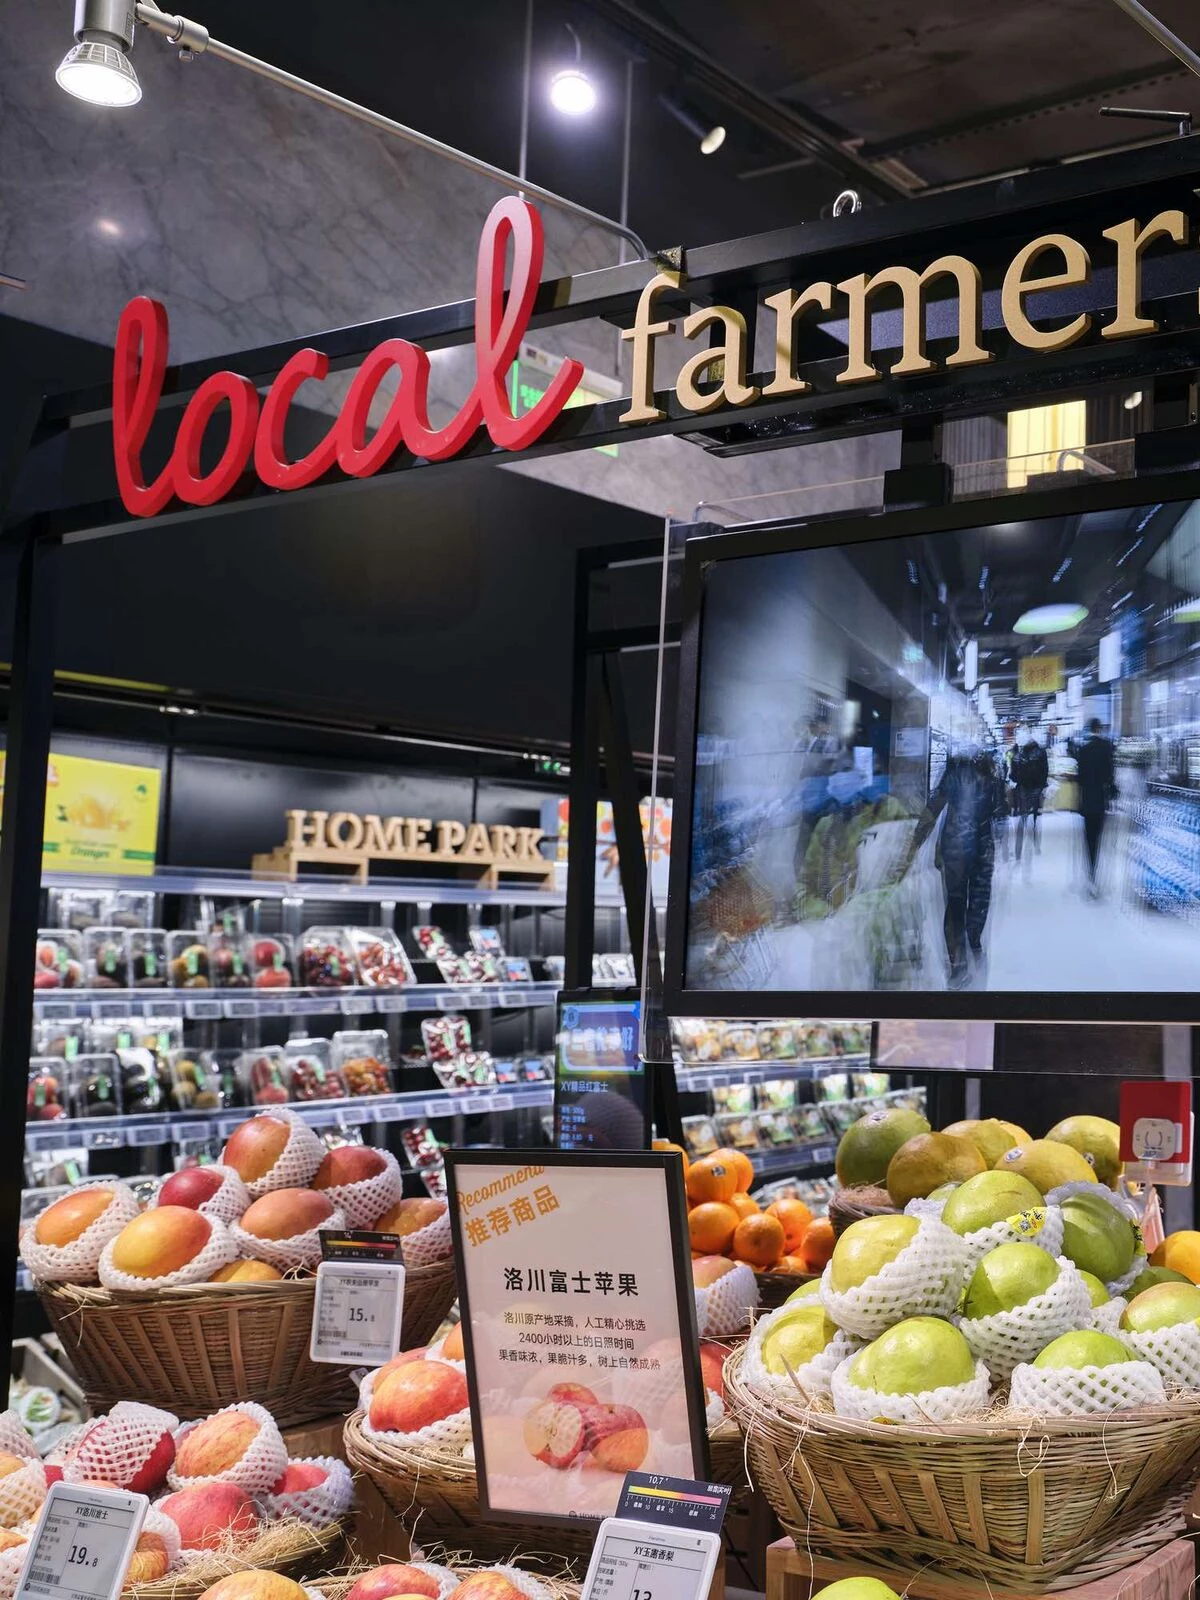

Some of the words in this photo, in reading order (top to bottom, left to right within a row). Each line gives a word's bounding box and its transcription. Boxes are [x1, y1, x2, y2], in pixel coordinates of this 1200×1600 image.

[112, 195, 585, 518] local
[286, 809, 433, 851] HOME
[436, 819, 545, 861] PARK
[465, 1185, 560, 1247] 推荐商品
[504, 1267, 639, 1297] 洛川富士苹果
[519, 1333, 635, 1350] 2400小时以上的日照时间
